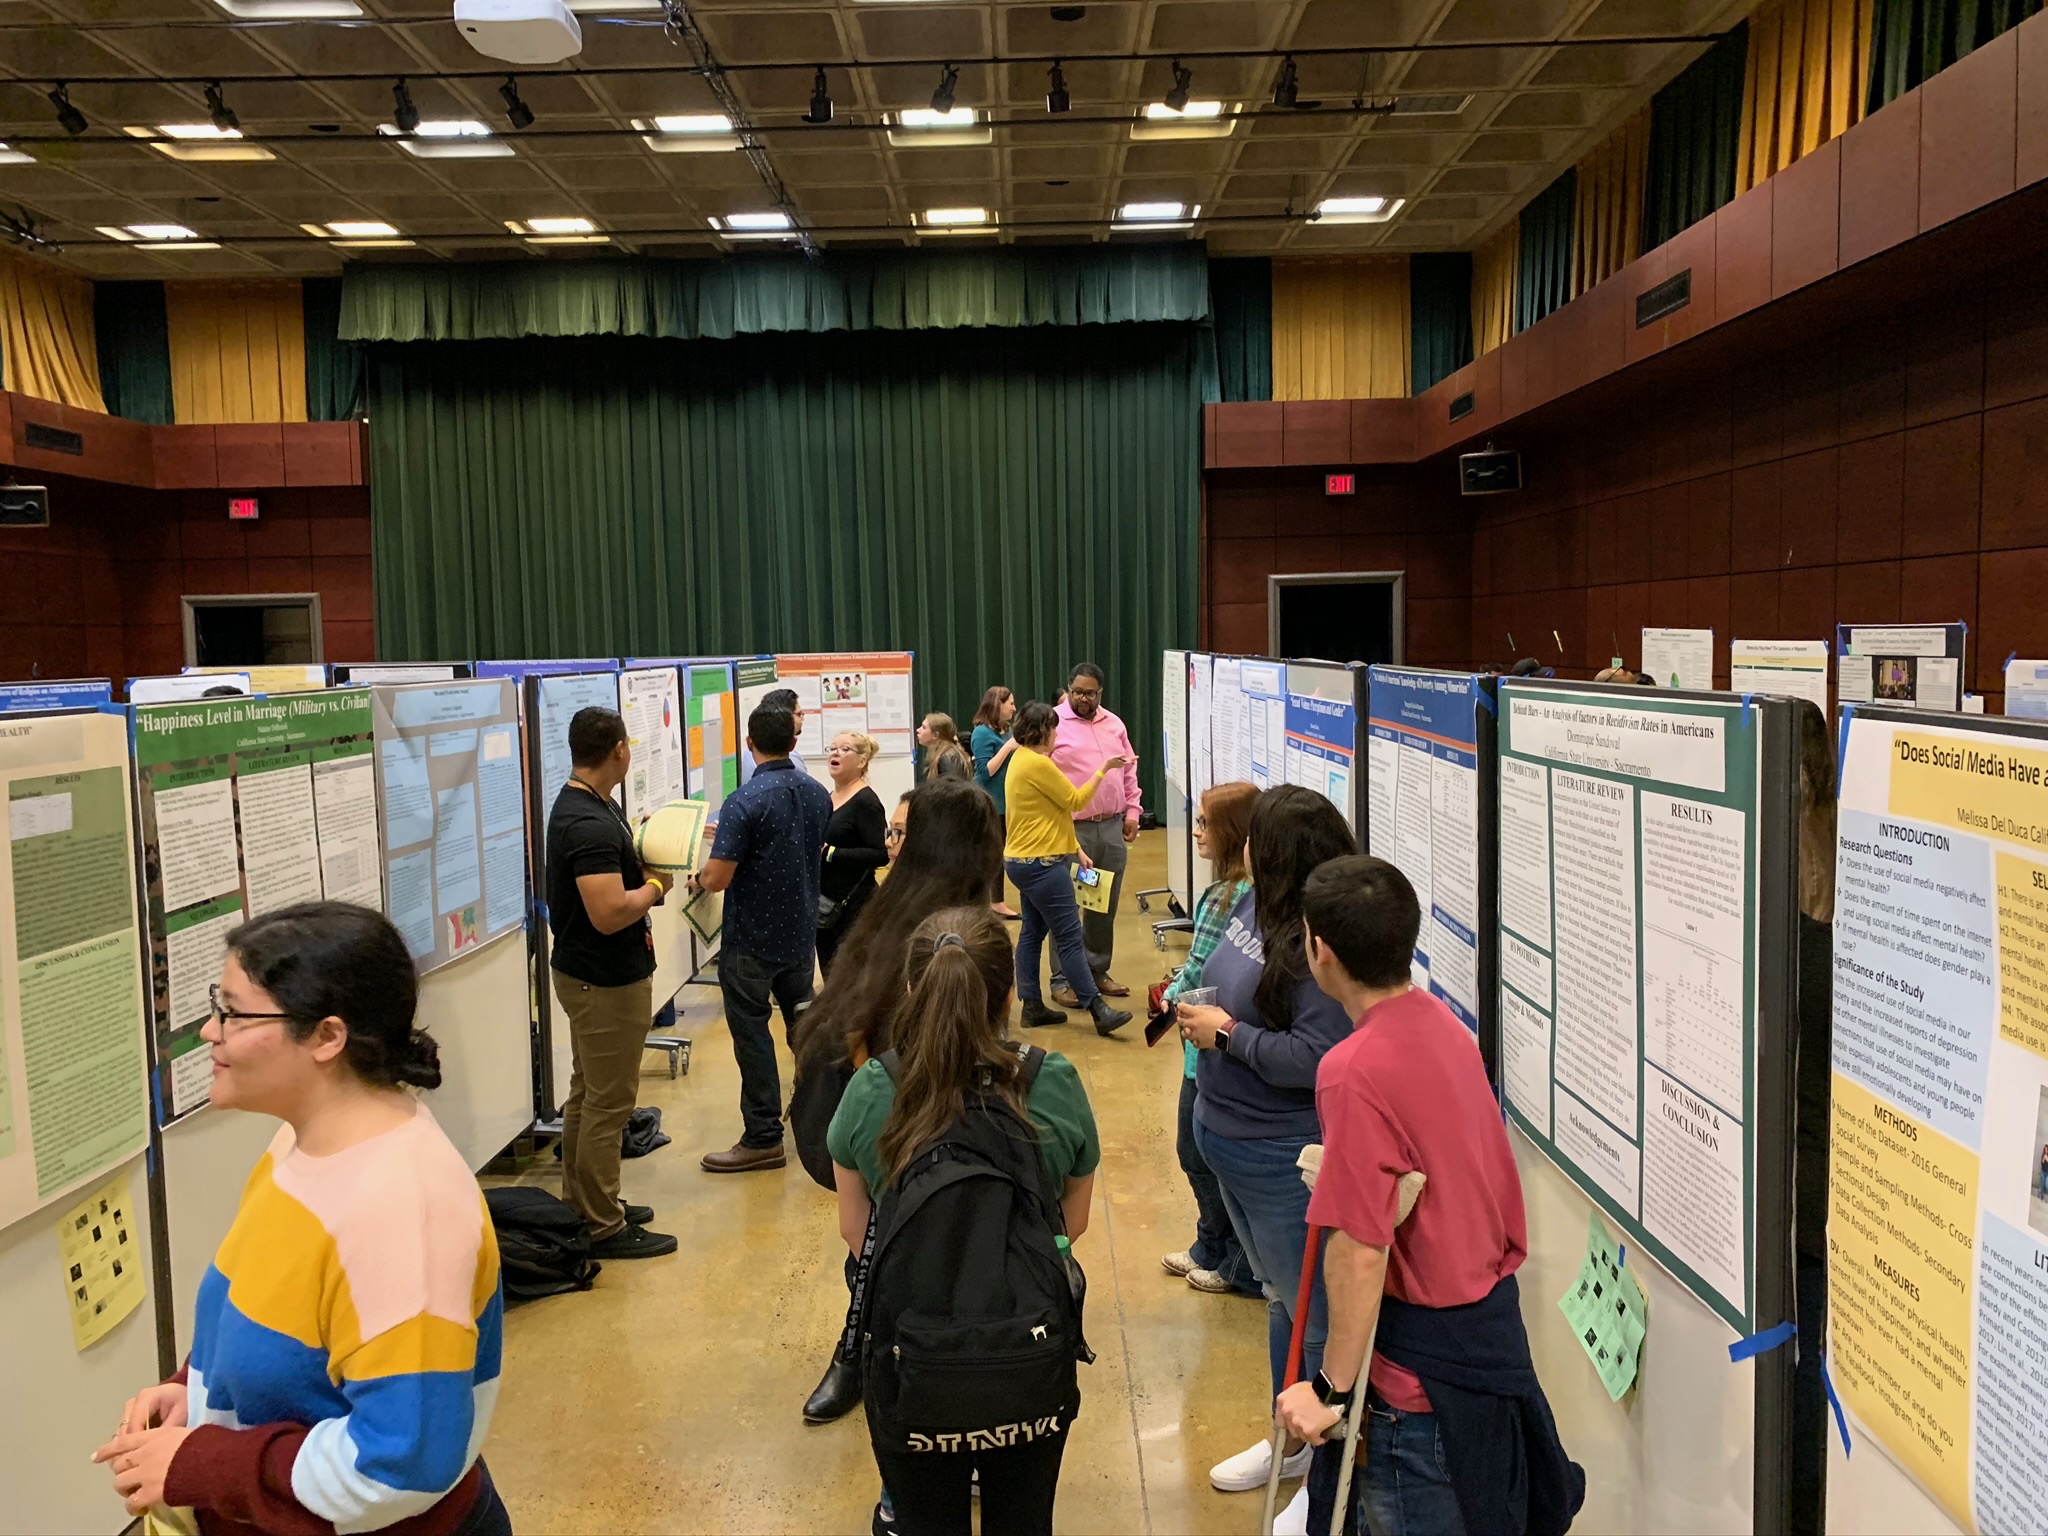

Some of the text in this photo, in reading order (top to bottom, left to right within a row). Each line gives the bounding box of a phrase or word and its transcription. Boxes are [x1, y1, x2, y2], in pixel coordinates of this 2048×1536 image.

[1329, 476, 1352, 493] EXIT
[231, 500, 256, 516] EXIT
[135, 711, 203, 735] “Happiness
[206, 706, 231, 725] Level
[233, 706, 243, 722] in
[245, 702, 287, 721] Marriage
[288, 699, 327, 719] (Military
[328, 700, 339, 711] vs.
[1614, 759, 1651, 777] Sacramento
[1894, 739, 2040, 785] “Does Social Media Have
[1671, 802, 1712, 825] RESULTS
[1957, 807, 1988, 829] Melissa
[1991, 814, 2006, 832] Del
[2007, 818, 2028, 840] Duca
[1839, 836, 1912, 865] Research Questions
[1879, 822, 1949, 852] INTRODUCTION
[1845, 875, 1890, 894] mental health?
[1846, 857, 1861, 870] Does
[1862, 862, 1872, 873] the
[1873, 867, 1885, 877] use
[1893, 872, 1912, 884] social
[1912, 877, 1934, 890] media
[1935, 883, 1968, 903] negatively
[1969, 892, 1986, 908] affect
[1843, 908, 1985, 962] and using social media affect mental health?
[1844, 889, 1859, 903] Does
[1860, 895, 1870, 907] the
[1871, 900, 1895, 915] amount
[1904, 909, 1920, 923] time
[1921, 916, 1941, 929] spent
[1953, 924, 1966, 937] the
[1967, 931, 1992, 948] internet
[1841, 940, 1856, 951] role?
[1847, 926, 1868, 939] mental
[1869, 931, 1889, 947] health
[1896, 942, 1923, 960] affected
[1924, 951, 1940, 967] does
[1941, 960, 1968, 976] gender
[1969, 969, 1985, 984] play
[1834, 952, 1874, 980] Significance
[1886, 974, 1898, 990] the
[1900, 979, 1924, 1002] Study
[1661, 1079, 1710, 1123] DISCUSSION
[1874, 1104, 1917, 1142] METHODS
[1569, 1112, 1620, 1162] Acknowledgements
[1662, 1102, 1718, 1152] CONCLUSION
[1836, 1122, 1878, 1161] Social Survey
[1836, 1103, 1856, 1125] Name
[1865, 1122, 1877, 1139] the
[1878, 1129, 1909, 1158] Dataset-
[1911, 1150, 1930, 1173] 2016
[1932, 1164, 1966, 1196] General
[1835, 1162, 1889, 1211] Sectional Design
[1836, 1142, 1972, 1249] Sample and Sampling Methods- Cross
[1835, 1201, 1878, 1245] Data Analysis
[1835, 1182, 1965, 1293] Data Collection Methods- Secondary
[1874, 1254, 1920, 1302] MEASURES
